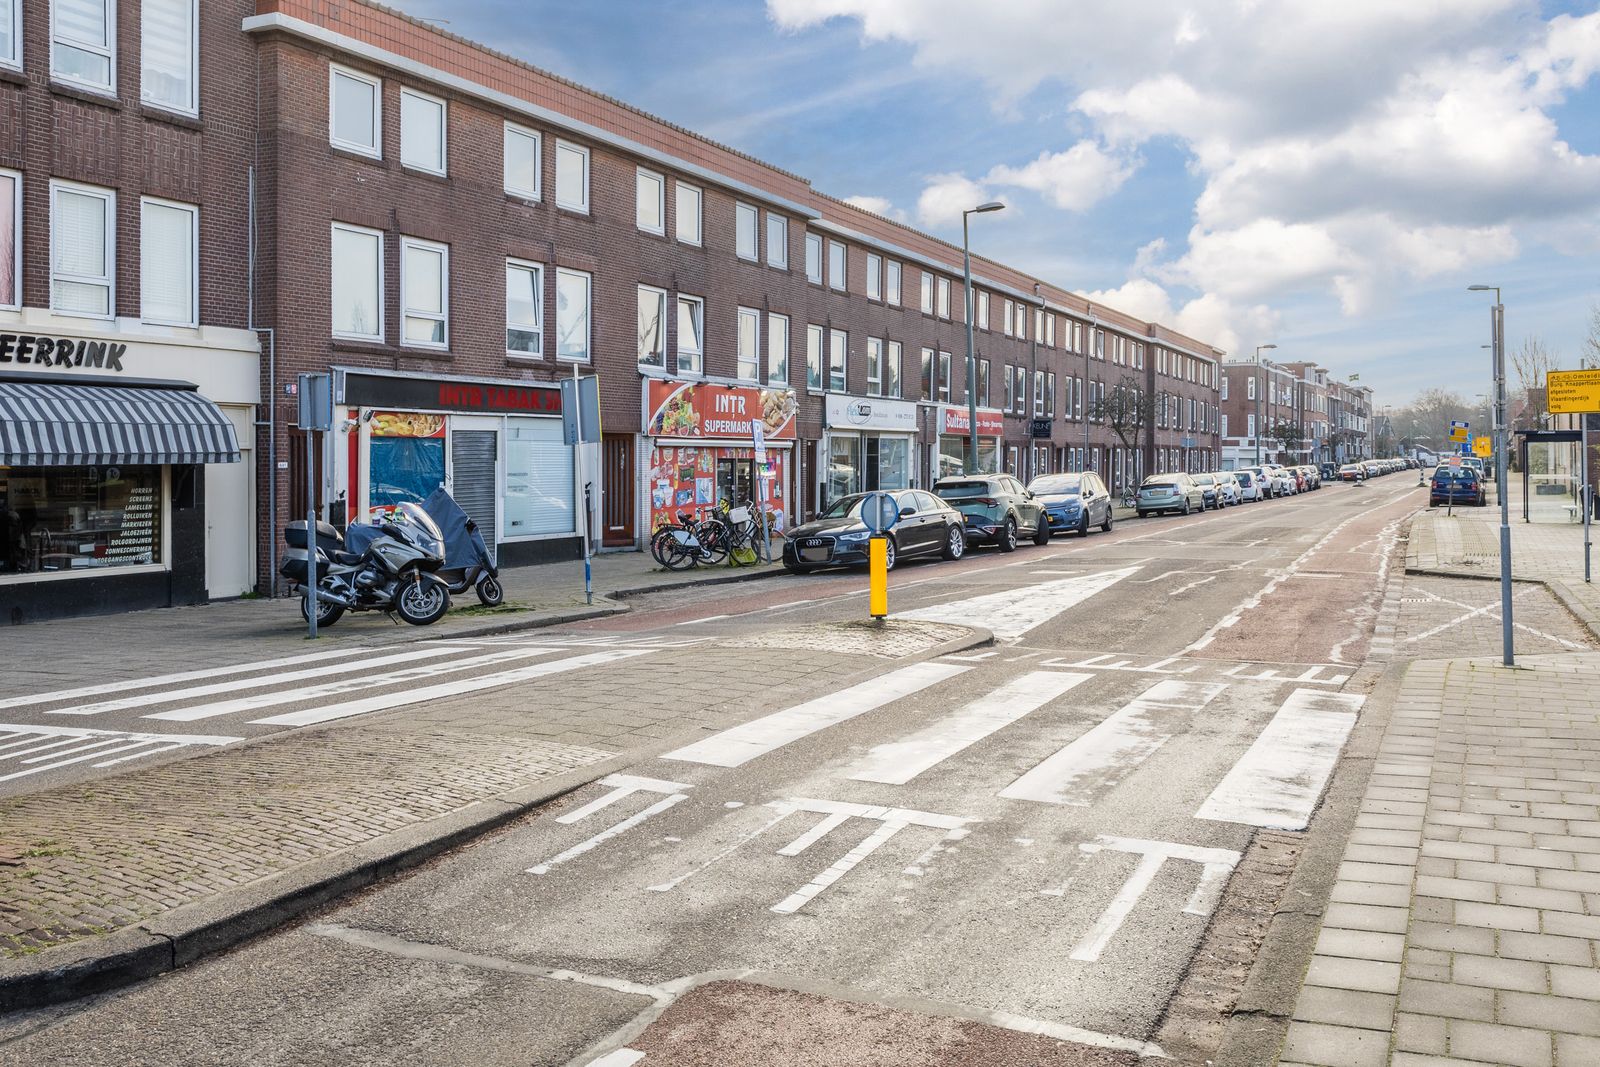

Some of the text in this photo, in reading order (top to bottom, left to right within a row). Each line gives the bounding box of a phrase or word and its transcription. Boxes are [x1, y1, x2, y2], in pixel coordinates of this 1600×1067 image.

[0, 334, 127, 372] EERRINK
[486, 387, 542, 410] TABAK
[715, 394, 746, 414] INTR
[704, 419, 752, 434] SUPERMARK
[123, 512, 153, 520] ROLLUIKEN
[121, 520, 153, 528] MARKIEZEN
[111, 537, 153, 546] ROLGORDIJNEN
[105, 545, 153, 555] ZONNESCHERMEN
